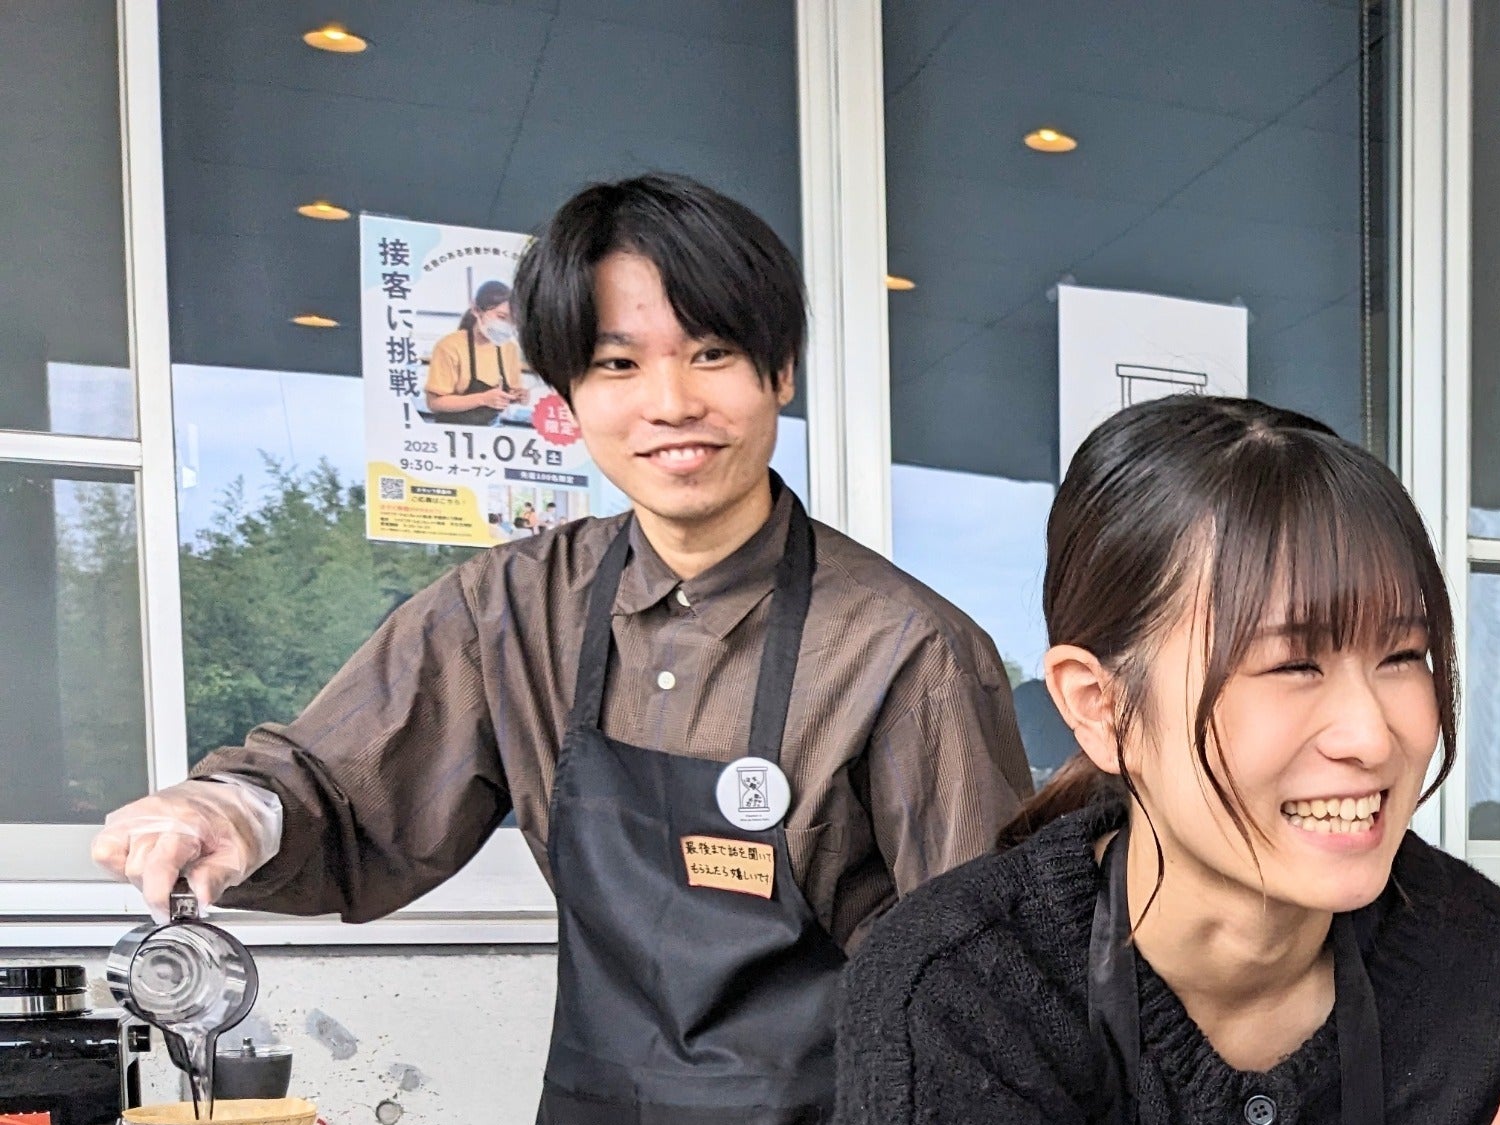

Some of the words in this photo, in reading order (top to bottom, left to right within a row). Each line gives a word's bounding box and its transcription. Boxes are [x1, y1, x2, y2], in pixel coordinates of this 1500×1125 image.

[544, 421, 576, 435] 限定
[404, 440, 438, 453] 2023
[444, 431, 542, 465] 11.04
[547, 451, 561, 465] 土
[447, 463, 496, 477] オープン
[685, 841, 773, 863] 最後まで話を聞いて
[690, 863, 770, 885] もらえたら嬉しいです
